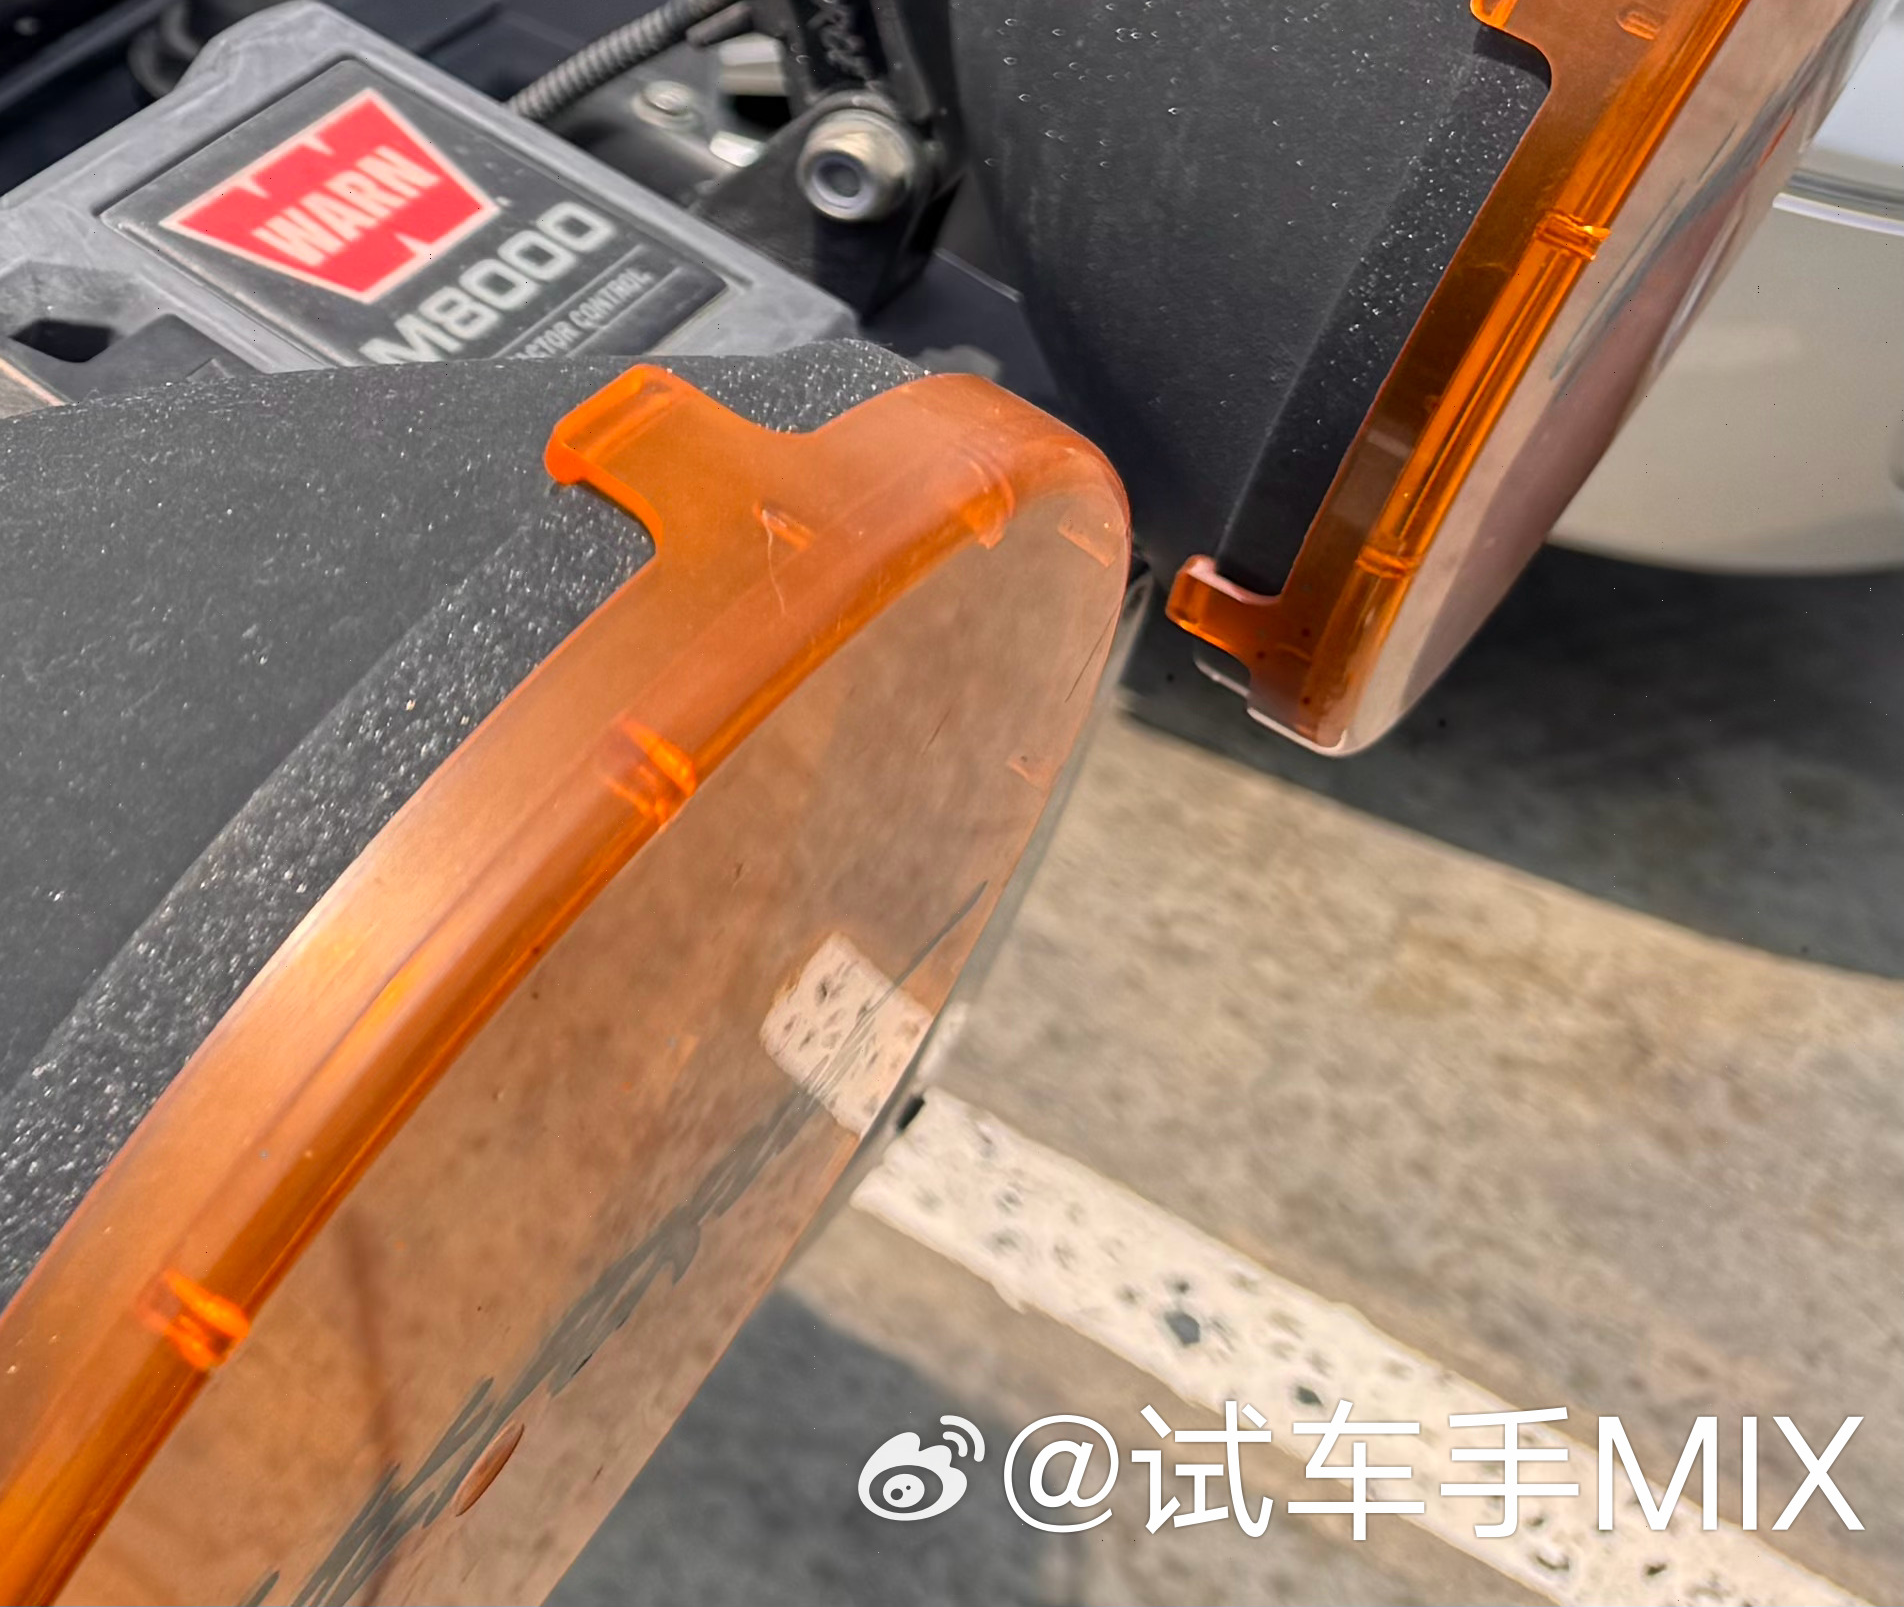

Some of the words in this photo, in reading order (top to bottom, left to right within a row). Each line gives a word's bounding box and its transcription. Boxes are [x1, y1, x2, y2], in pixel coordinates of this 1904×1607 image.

[251, 144, 442, 267] WARN
[358, 201, 617, 365] M8000
[568, 268, 654, 329] CONTROL
